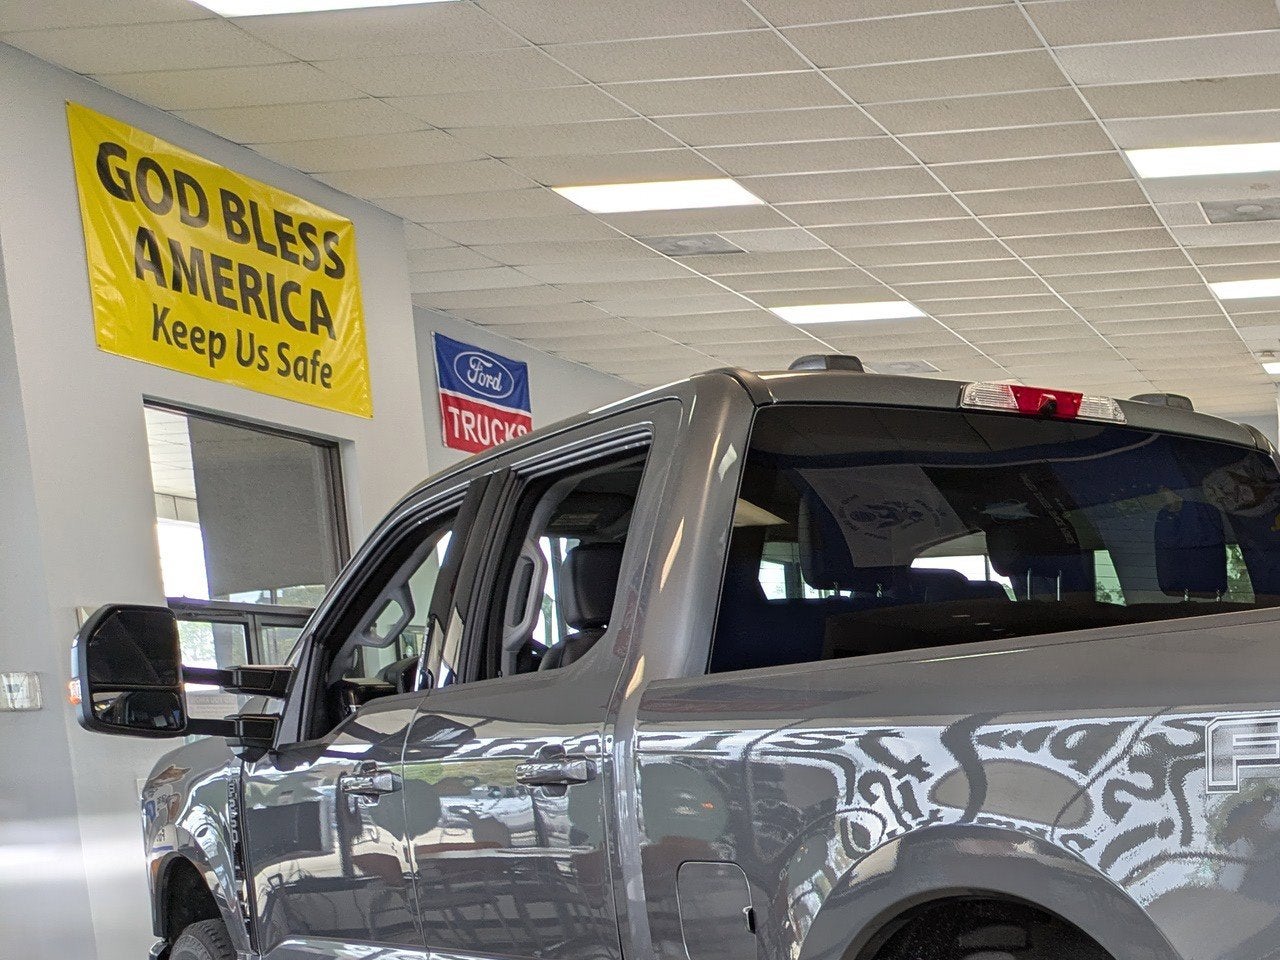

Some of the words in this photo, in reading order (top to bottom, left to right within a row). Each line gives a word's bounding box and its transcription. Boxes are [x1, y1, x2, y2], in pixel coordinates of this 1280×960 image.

[96, 142, 210, 229] GOD
[219, 188, 346, 280] BLESS
[134, 226, 337, 341] AMERICA
[152, 302, 227, 369] Keep
[236, 328, 270, 372] Us
[277, 341, 333, 389] Safe
[467, 356, 503, 392] Ford
